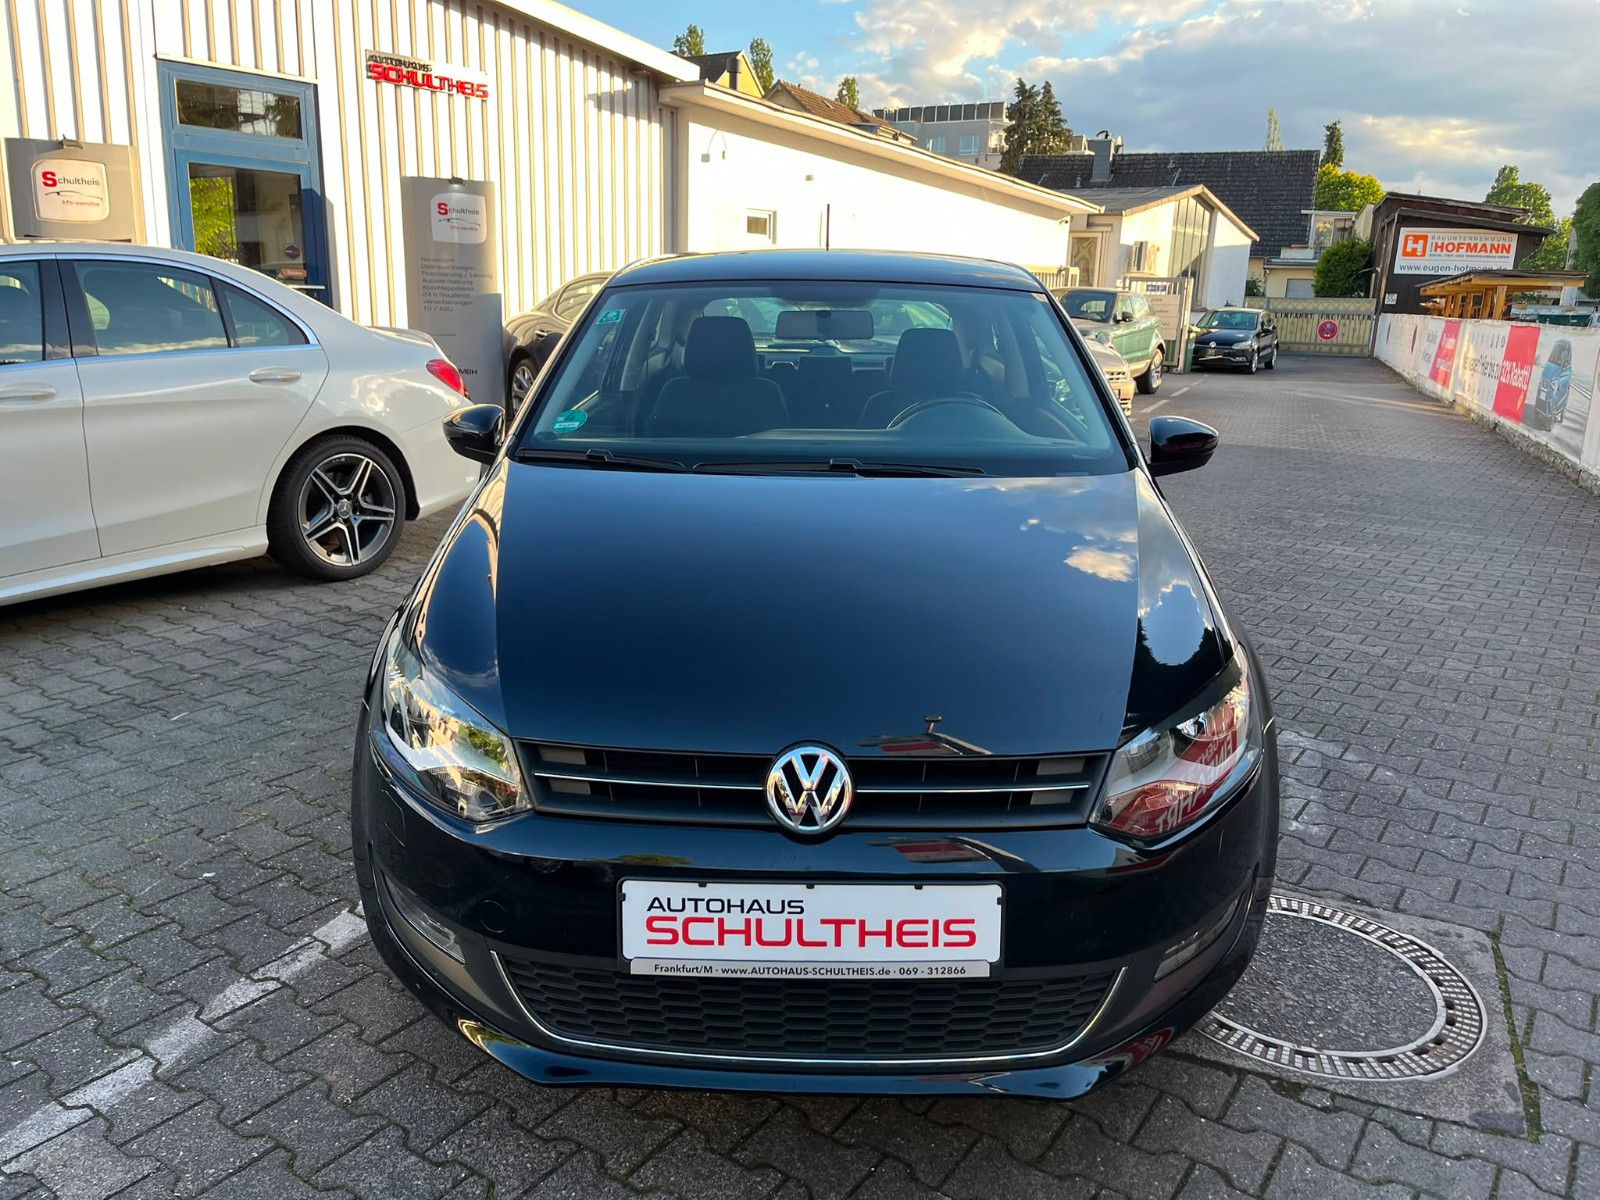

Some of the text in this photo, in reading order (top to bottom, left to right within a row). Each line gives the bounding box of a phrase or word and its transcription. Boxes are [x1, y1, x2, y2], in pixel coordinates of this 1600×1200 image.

[42, 171, 100, 188] Schultheis
[437, 202, 480, 216] Schultheis
[1433, 242, 1512, 254] HOFMANN
[1274, 312, 1314, 320] EINFAHRT
[646, 896, 805, 915] AUTOHAUS
[645, 915, 977, 948] SCHULTHEIS
[654, 963, 713, 974] Frankfurt/M
[721, 965, 891, 976] www.AUTOHAUS-SCHULTHEIS.de
[899, 966, 919, 975] 069
[927, 966, 966, 975] 312866
